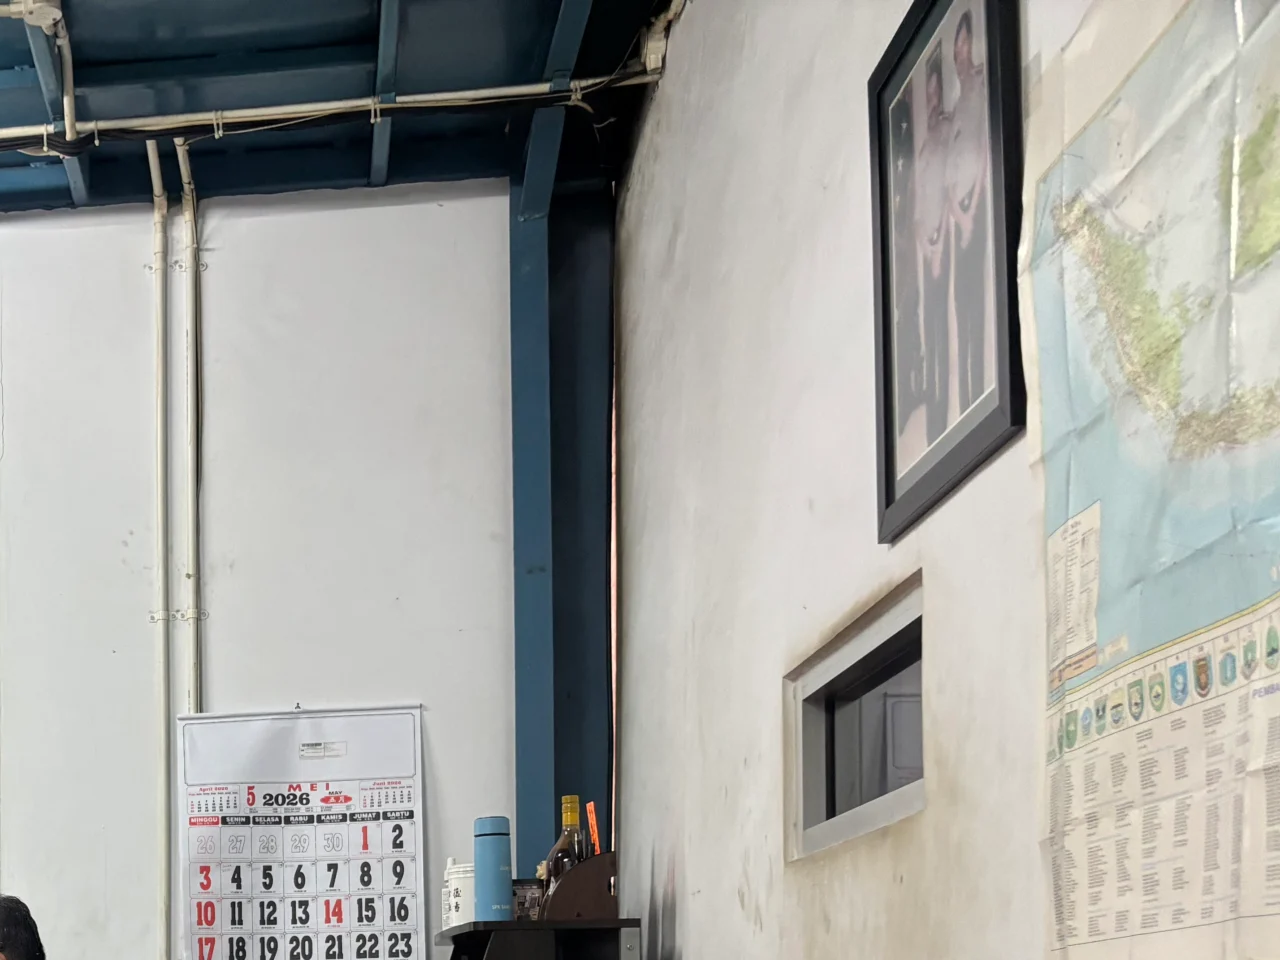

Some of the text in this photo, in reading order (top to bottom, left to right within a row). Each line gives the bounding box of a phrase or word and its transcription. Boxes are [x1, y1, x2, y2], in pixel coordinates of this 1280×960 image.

[246, 785, 257, 807] 5
[262, 792, 311, 807] 2026
[288, 783, 330, 792] MEI
[197, 823, 404, 854] 26 27 28 29 30 1 2
[199, 859, 405, 891] 3 4 5 6 7 8 9
[196, 896, 409, 927] 10 11 12 13 14 15 16
[288, 935, 313, 960] 20
[324, 934, 344, 960] 21
[355, 933, 380, 959] 22
[387, 932, 413, 958] 23
